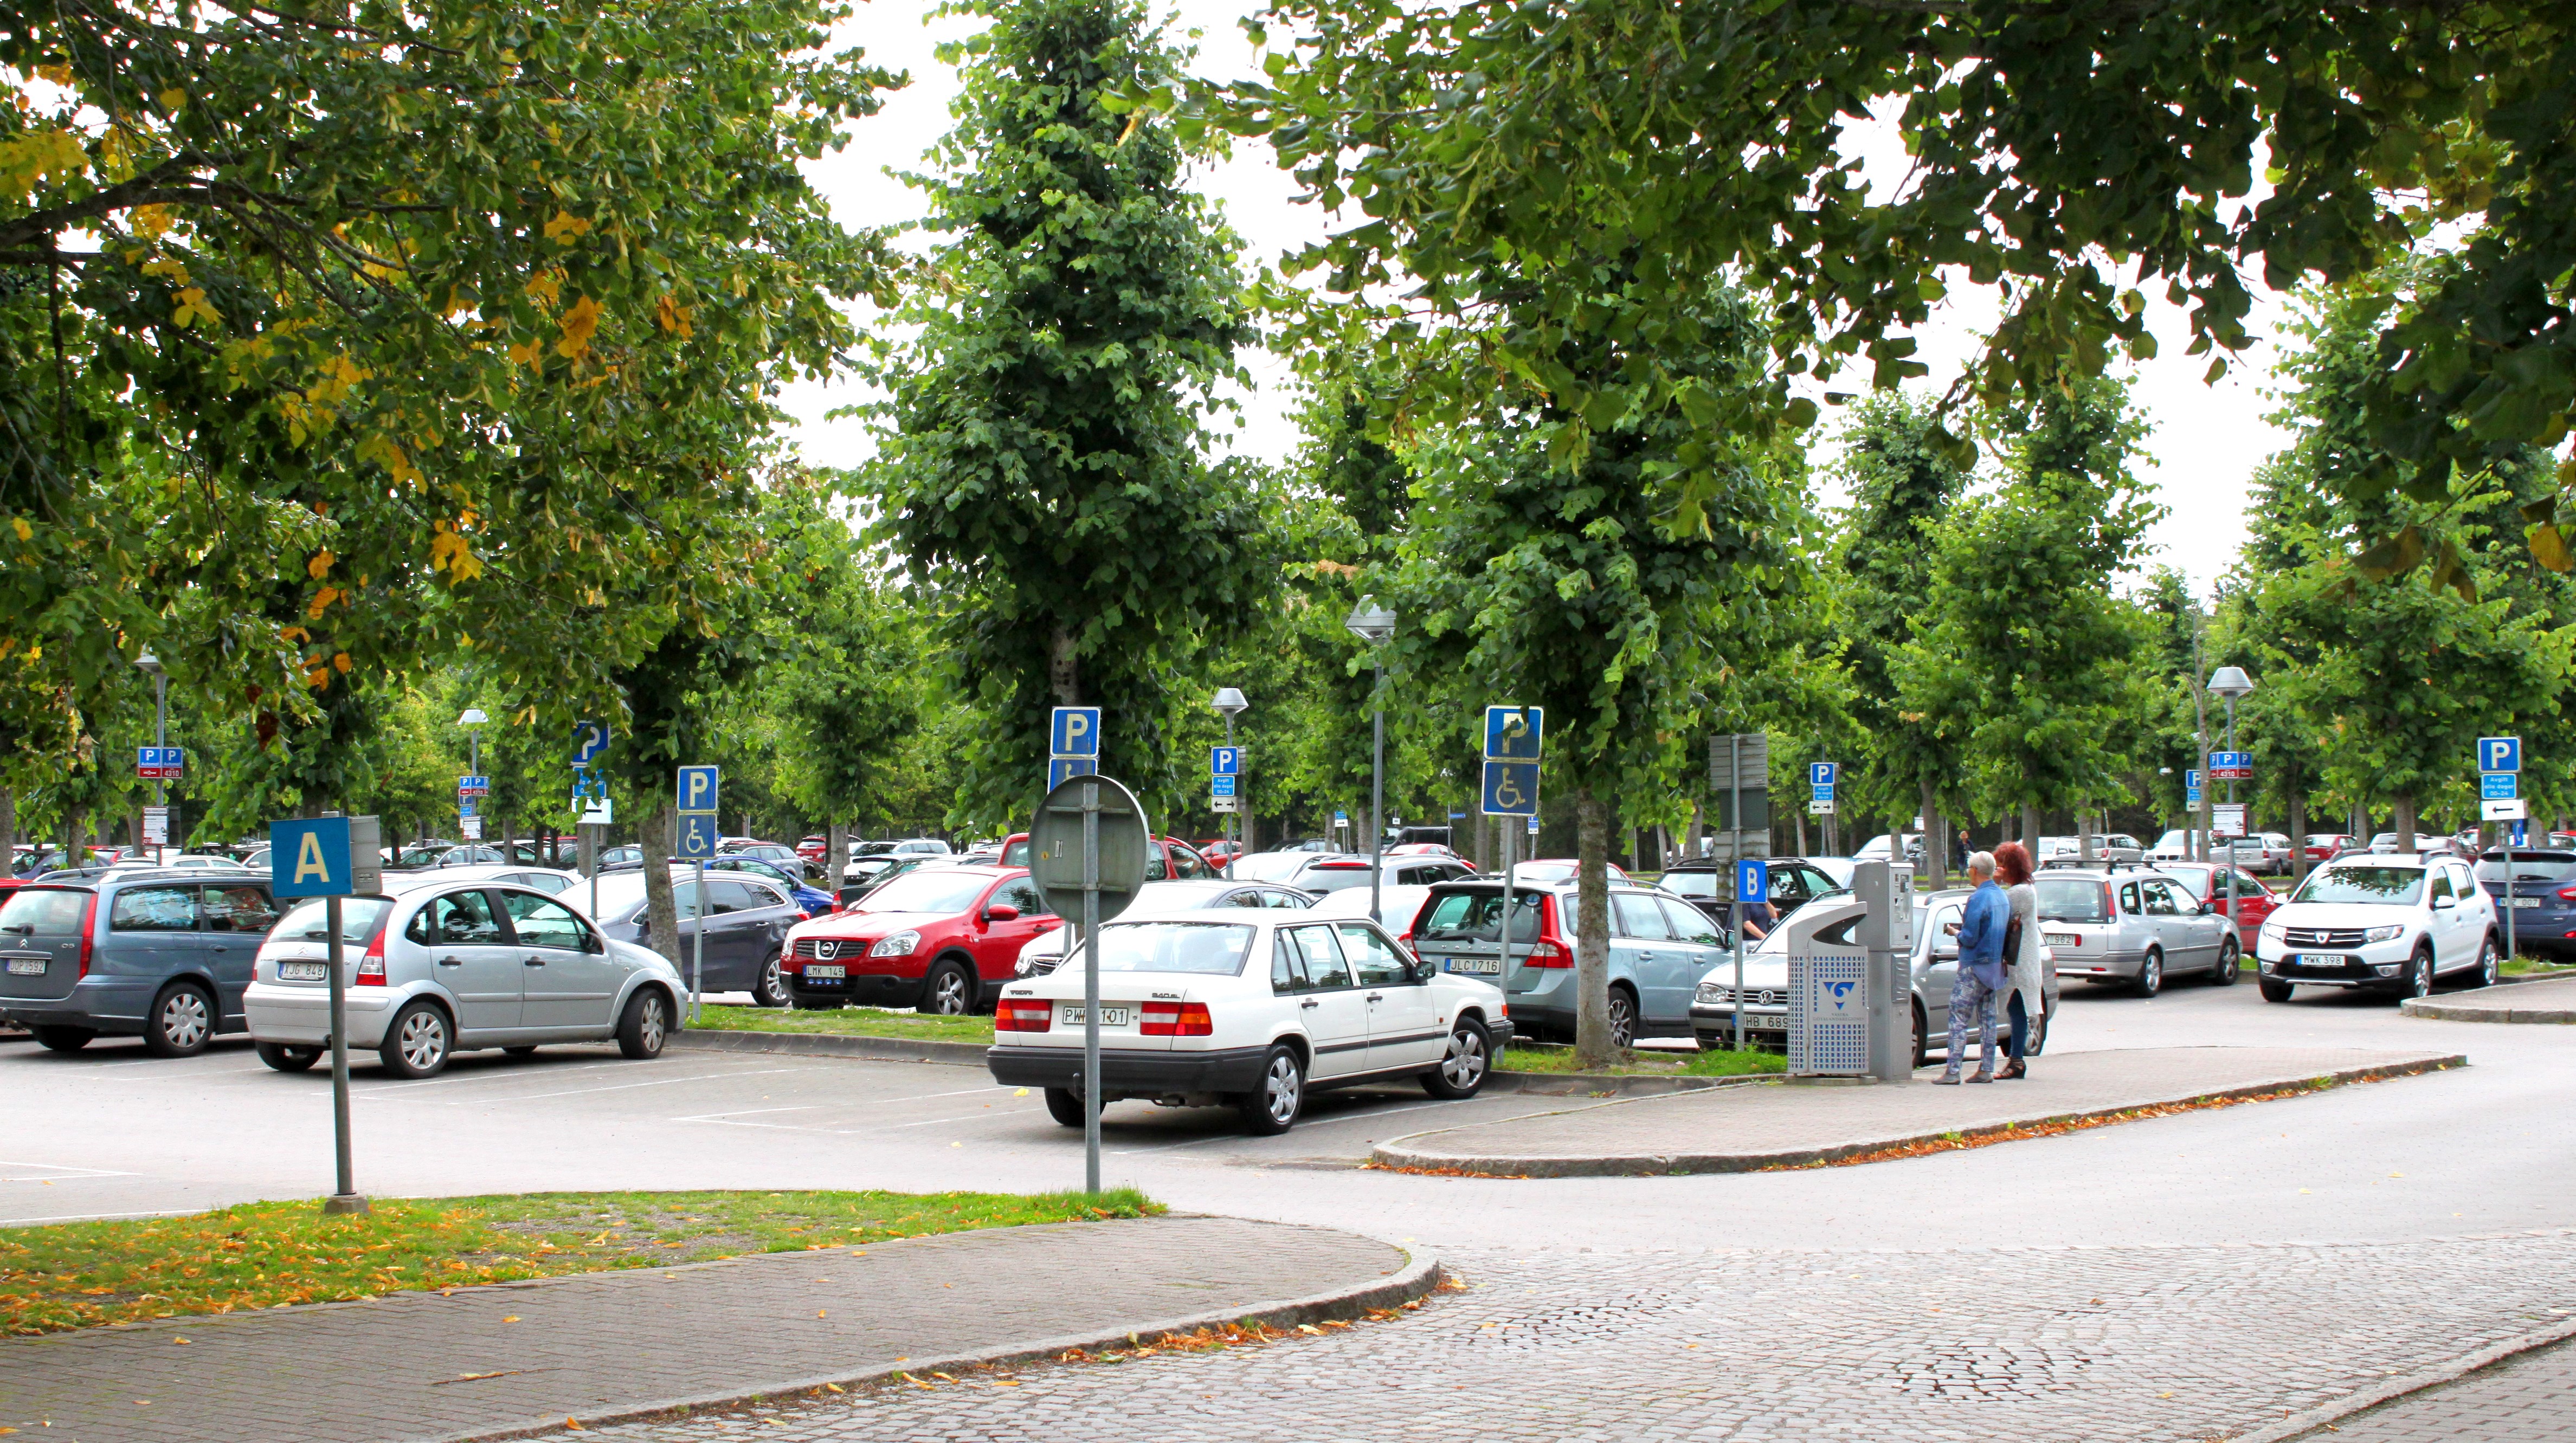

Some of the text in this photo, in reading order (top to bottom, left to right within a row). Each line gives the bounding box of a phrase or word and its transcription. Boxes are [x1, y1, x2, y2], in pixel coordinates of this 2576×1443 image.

[1065, 713, 1089, 751] P
[1502, 713, 1529, 753] P
[146, 750, 154, 761] P
[168, 750, 176, 761] P
[1219, 750, 1232, 772] P
[2224, 754, 2232, 764] P
[2242, 755, 2248, 764] P
[2491, 742, 2510, 769] P
[1818, 765, 1830, 782] P
[2192, 772, 2201, 786] P
[690, 772, 709, 807] P
[293, 832, 330, 884] A
[1747, 867, 1757, 895] B
[2055, 935, 2071, 944] 962
[29, 961, 43, 972] 592
[1451, 959, 1498, 971] JLC 716
[2304, 956, 2341, 964] MWK 398
[284, 963, 323, 976] XJG 848
[807, 967, 843, 976] LMK 145
[1102, 1009, 1124, 1023] 101
[1743, 1016, 1788, 1028] HB 689
